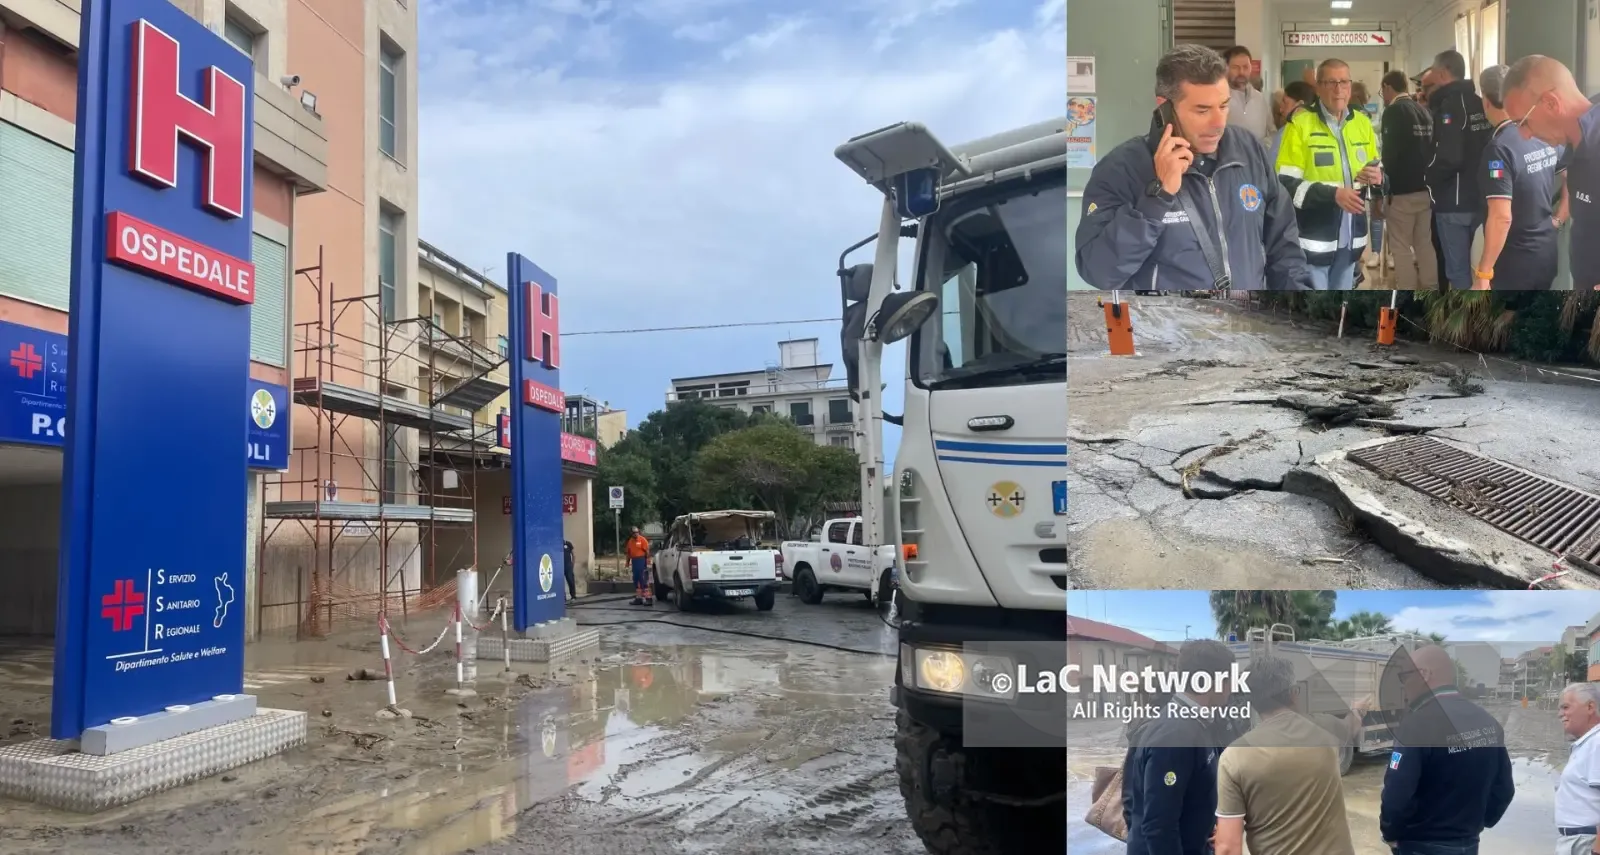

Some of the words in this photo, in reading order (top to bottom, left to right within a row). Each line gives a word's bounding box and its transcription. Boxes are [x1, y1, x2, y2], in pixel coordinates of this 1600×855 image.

[1301, 33, 1329, 44] PRONTO
[1331, 33, 1368, 44] SOCCORSO
[128, 18, 245, 218] H
[121, 226, 250, 295] OSPEDALE
[526, 281, 560, 370] H
[530, 386, 564, 409] OSPEDALE
[115, 655, 169, 672] Dipartimento
[170, 652, 194, 663] Salute
[200, 647, 226, 657] Welfare
